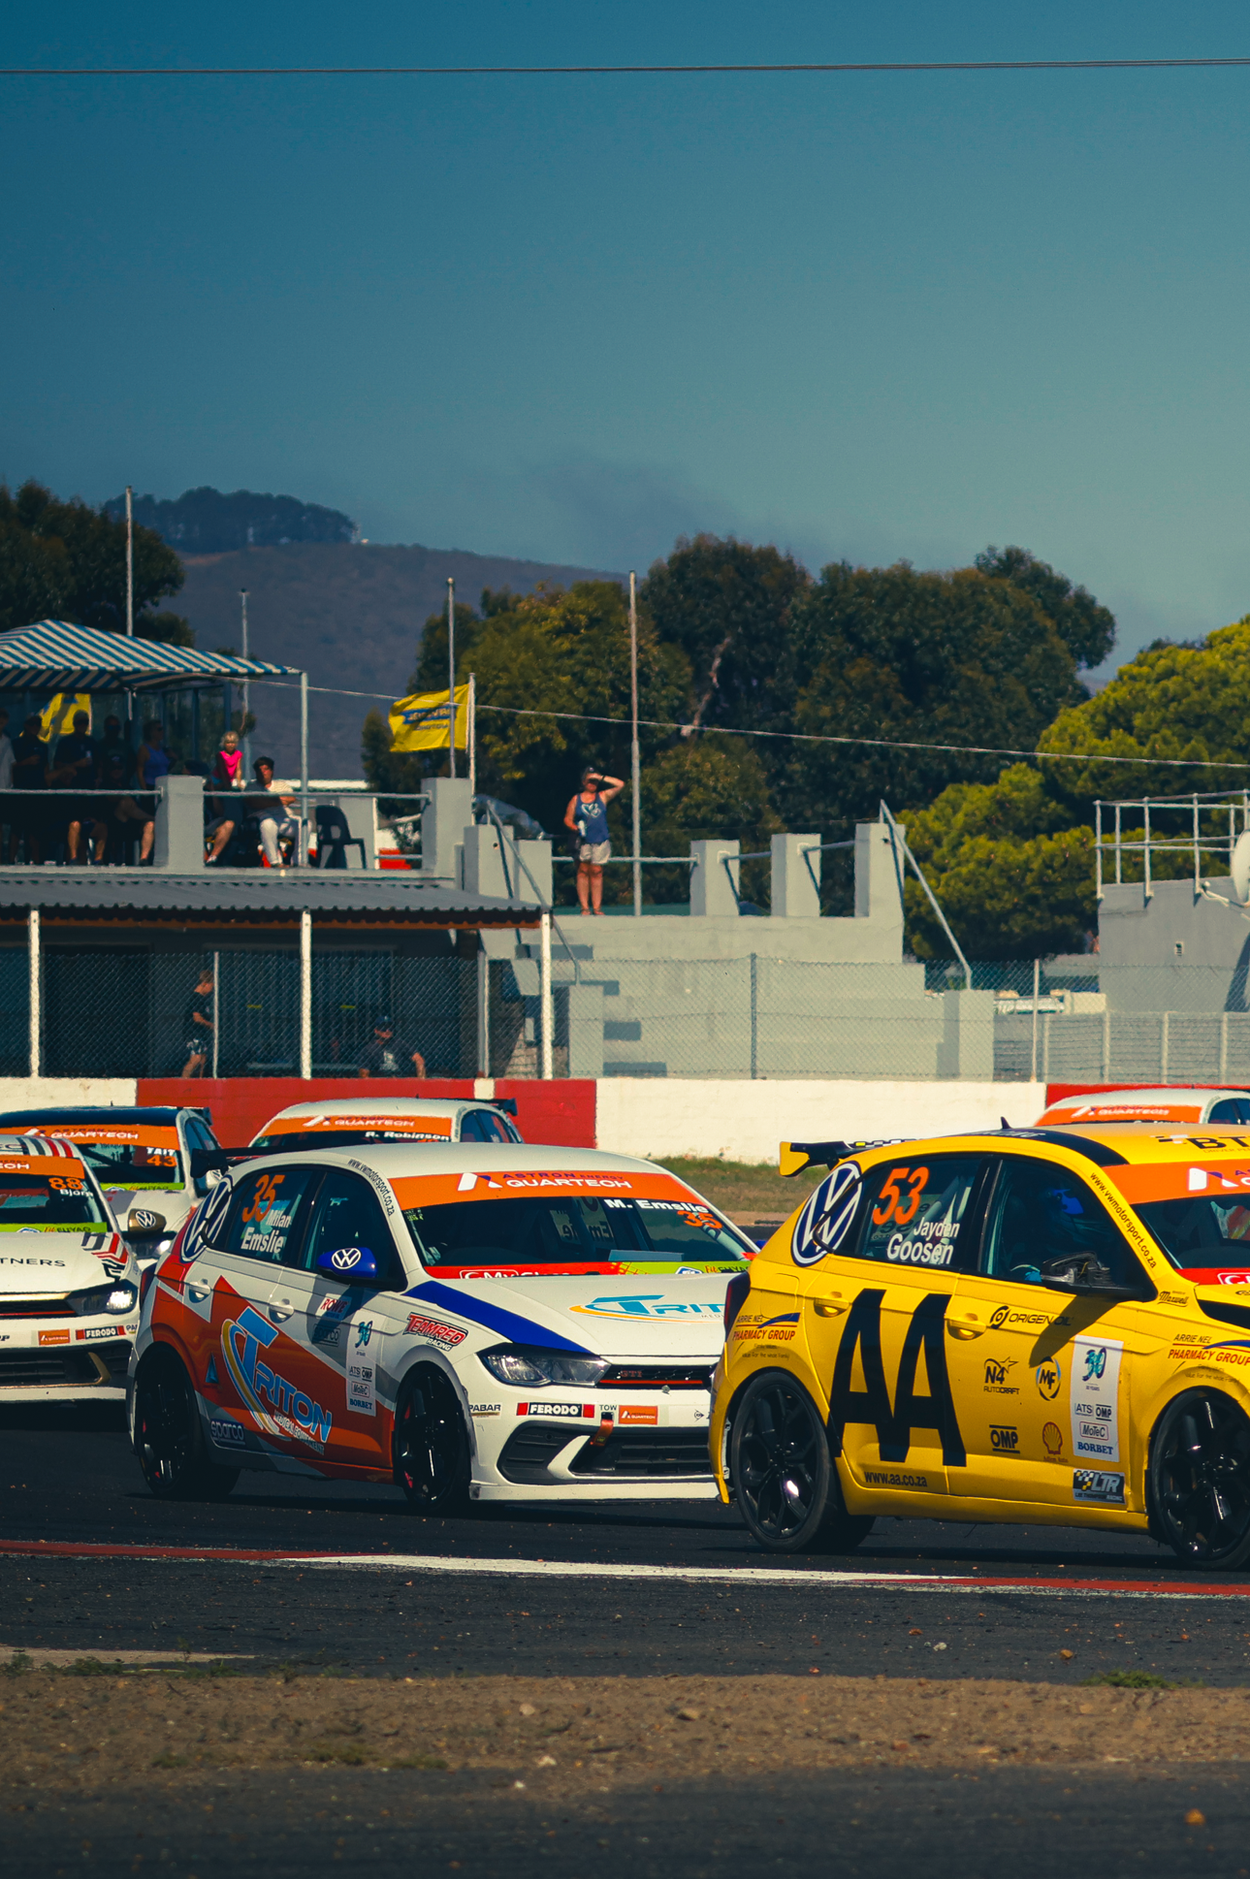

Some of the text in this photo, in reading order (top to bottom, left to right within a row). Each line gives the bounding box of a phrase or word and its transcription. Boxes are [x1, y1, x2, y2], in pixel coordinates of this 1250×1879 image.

[50, 1131, 139, 1140] QUARTECH
[384, 1131, 450, 1141] Robinson
[146, 1147, 176, 1156] TAIT
[146, 1155, 178, 1167] 43
[48, 1177, 83, 1190] 88
[506, 1178, 633, 1189] QUARTECH
[242, 1174, 286, 1223] 35
[872, 1166, 930, 1225] 53
[603, 1198, 709, 1214] M. Emslie
[265, 1209, 292, 1229] Milan
[677, 1209, 723, 1229] 35
[1089, 1172, 1158, 1269] www.vwmotorsport.co.za
[913, 1216, 961, 1241] Jayden
[240, 1226, 285, 1254] Emslie
[886, 1233, 954, 1265] Goosen
[1008, 1313, 1072, 1327] ORIGEN OIL
[86, 1327, 117, 1338] FERODO
[407, 1313, 468, 1345] TEAMRED
[732, 1329, 796, 1341] PHARMACY GROUP
[1173, 1333, 1212, 1344] ARRIE NEL
[1167, 1349, 1215, 1361] PHARMACY
[235, 1306, 332, 1443] TRITON
[620, 1370, 643, 1378] GTI
[826, 1288, 968, 1468] AA
[984, 1365, 1006, 1385] N4
[983, 1385, 1020, 1395] AUTOCRAFT
[350, 1398, 373, 1410] BORBET
[468, 1403, 501, 1412] PABAR
[529, 1403, 579, 1415] FERODO
[1076, 1403, 1093, 1414] ATS
[1095, 1405, 1112, 1419] OMP
[211, 1420, 244, 1441] sparco
[1082, 1424, 1106, 1438] MoTeC
[990, 1429, 1019, 1449] OMP
[1077, 1441, 1114, 1455] BORBET
[864, 1471, 928, 1487] www.aa.co.za
[1091, 1473, 1120, 1493] LTR
